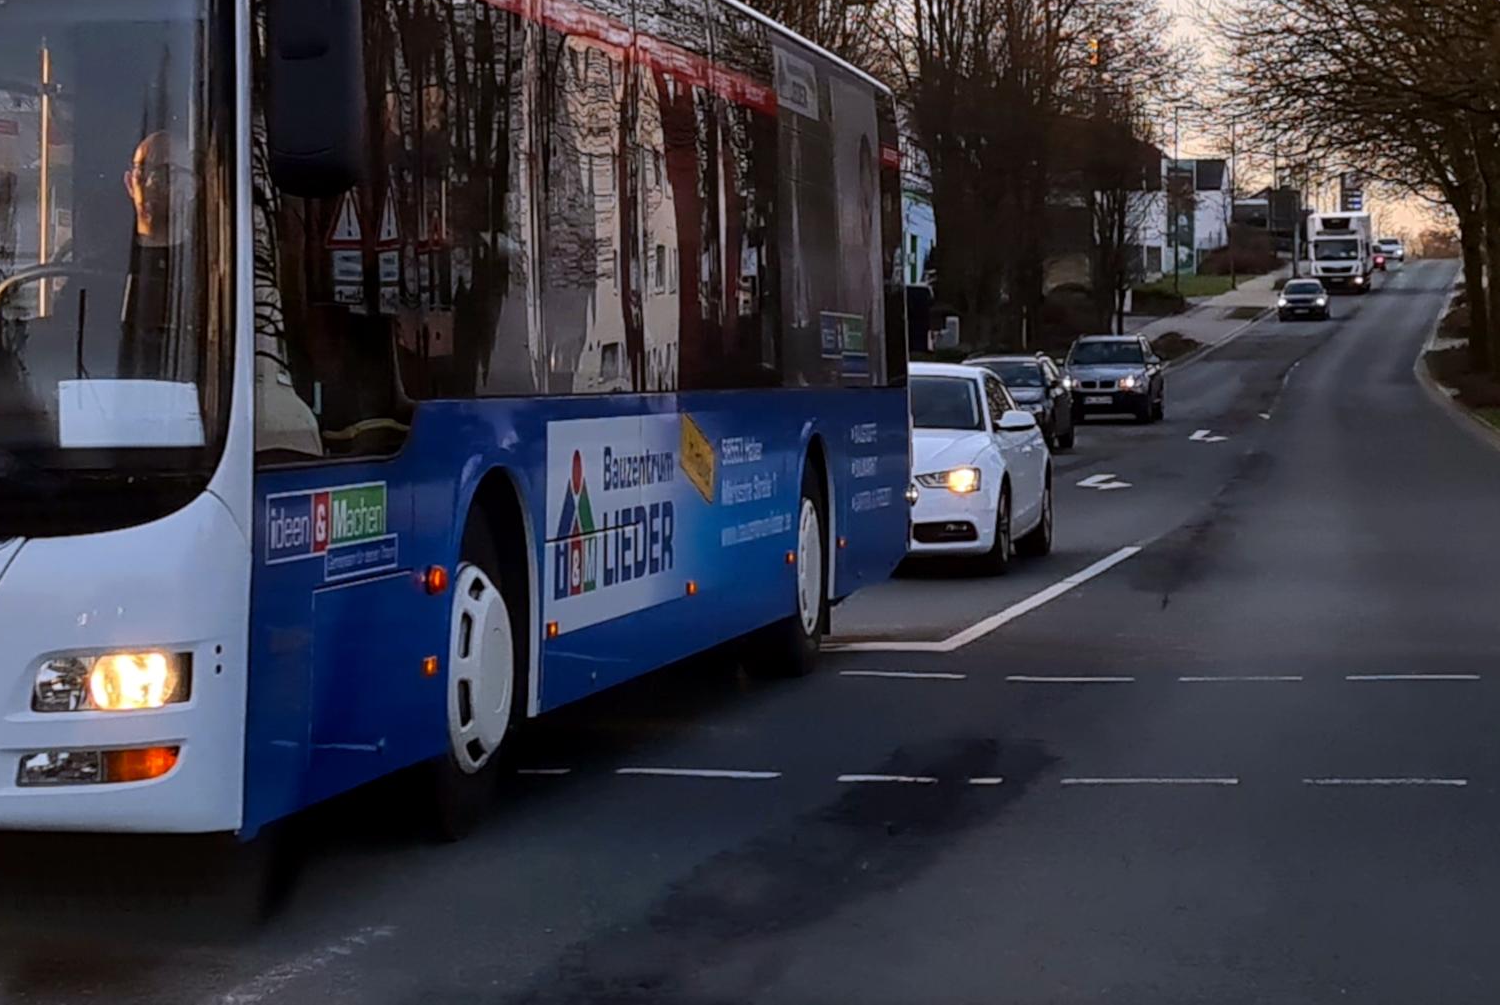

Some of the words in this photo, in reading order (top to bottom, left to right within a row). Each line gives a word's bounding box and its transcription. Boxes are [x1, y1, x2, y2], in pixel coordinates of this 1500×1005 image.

[603, 446, 675, 491] Bauzentrum
[315, 503, 326, 543] &
[333, 497, 383, 540] Machen
[603, 500, 674, 587] LIEDER
